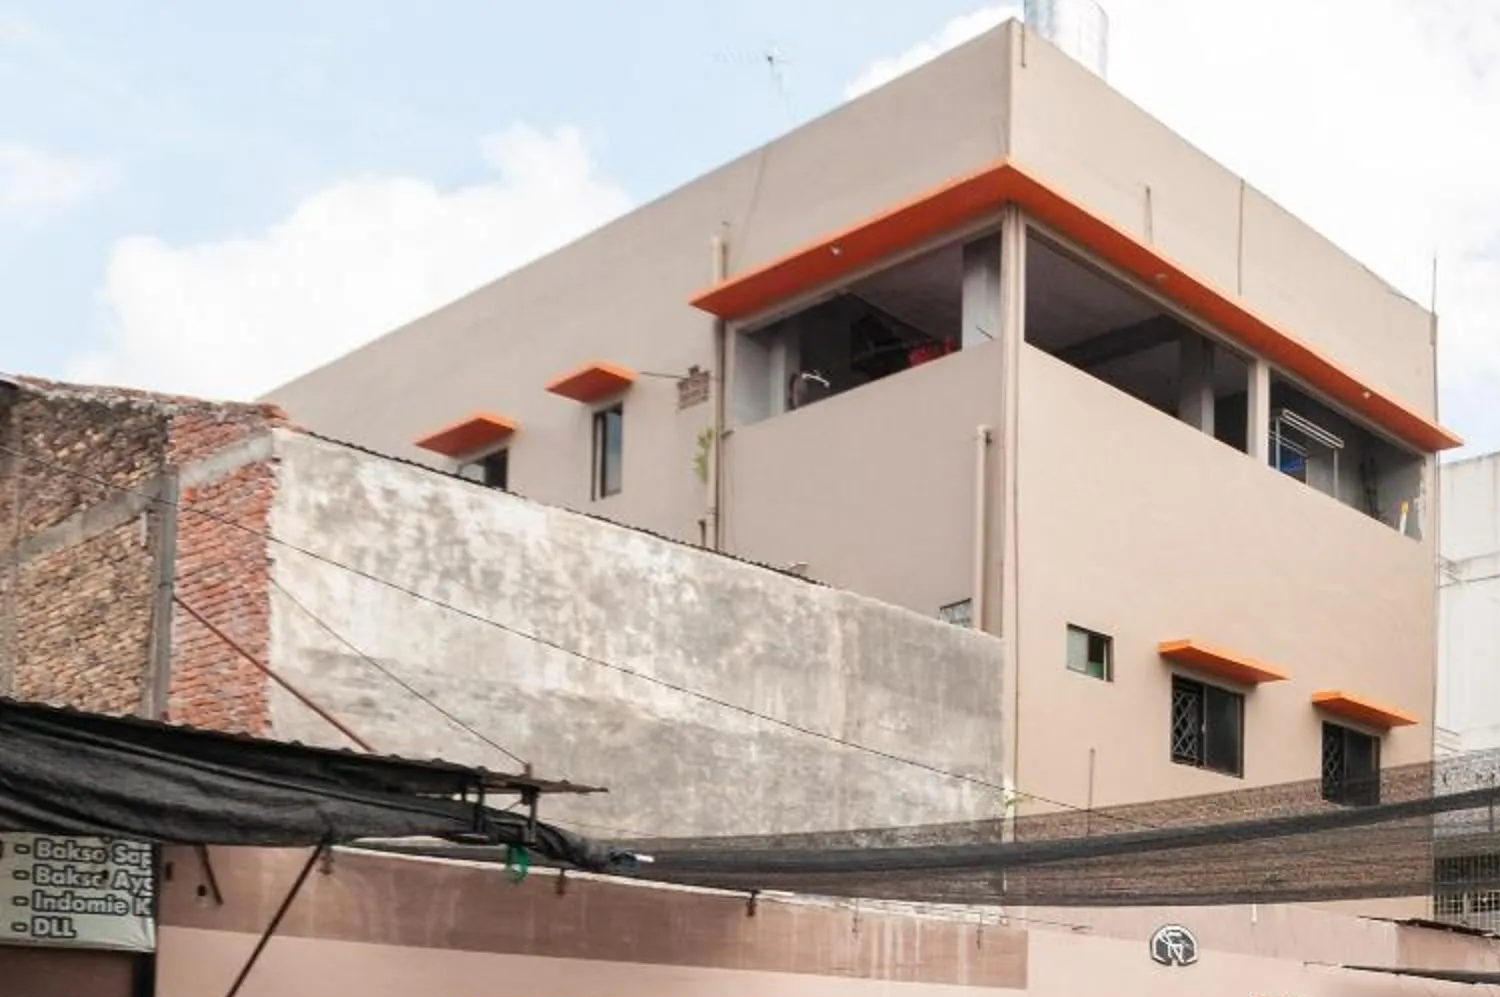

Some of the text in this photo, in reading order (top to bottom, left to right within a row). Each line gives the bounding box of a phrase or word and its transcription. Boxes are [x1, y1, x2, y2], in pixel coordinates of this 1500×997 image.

[34, 838, 109, 864] Bakso
[32, 889, 130, 916] Indomie
[31, 915, 77, 938] DLL
